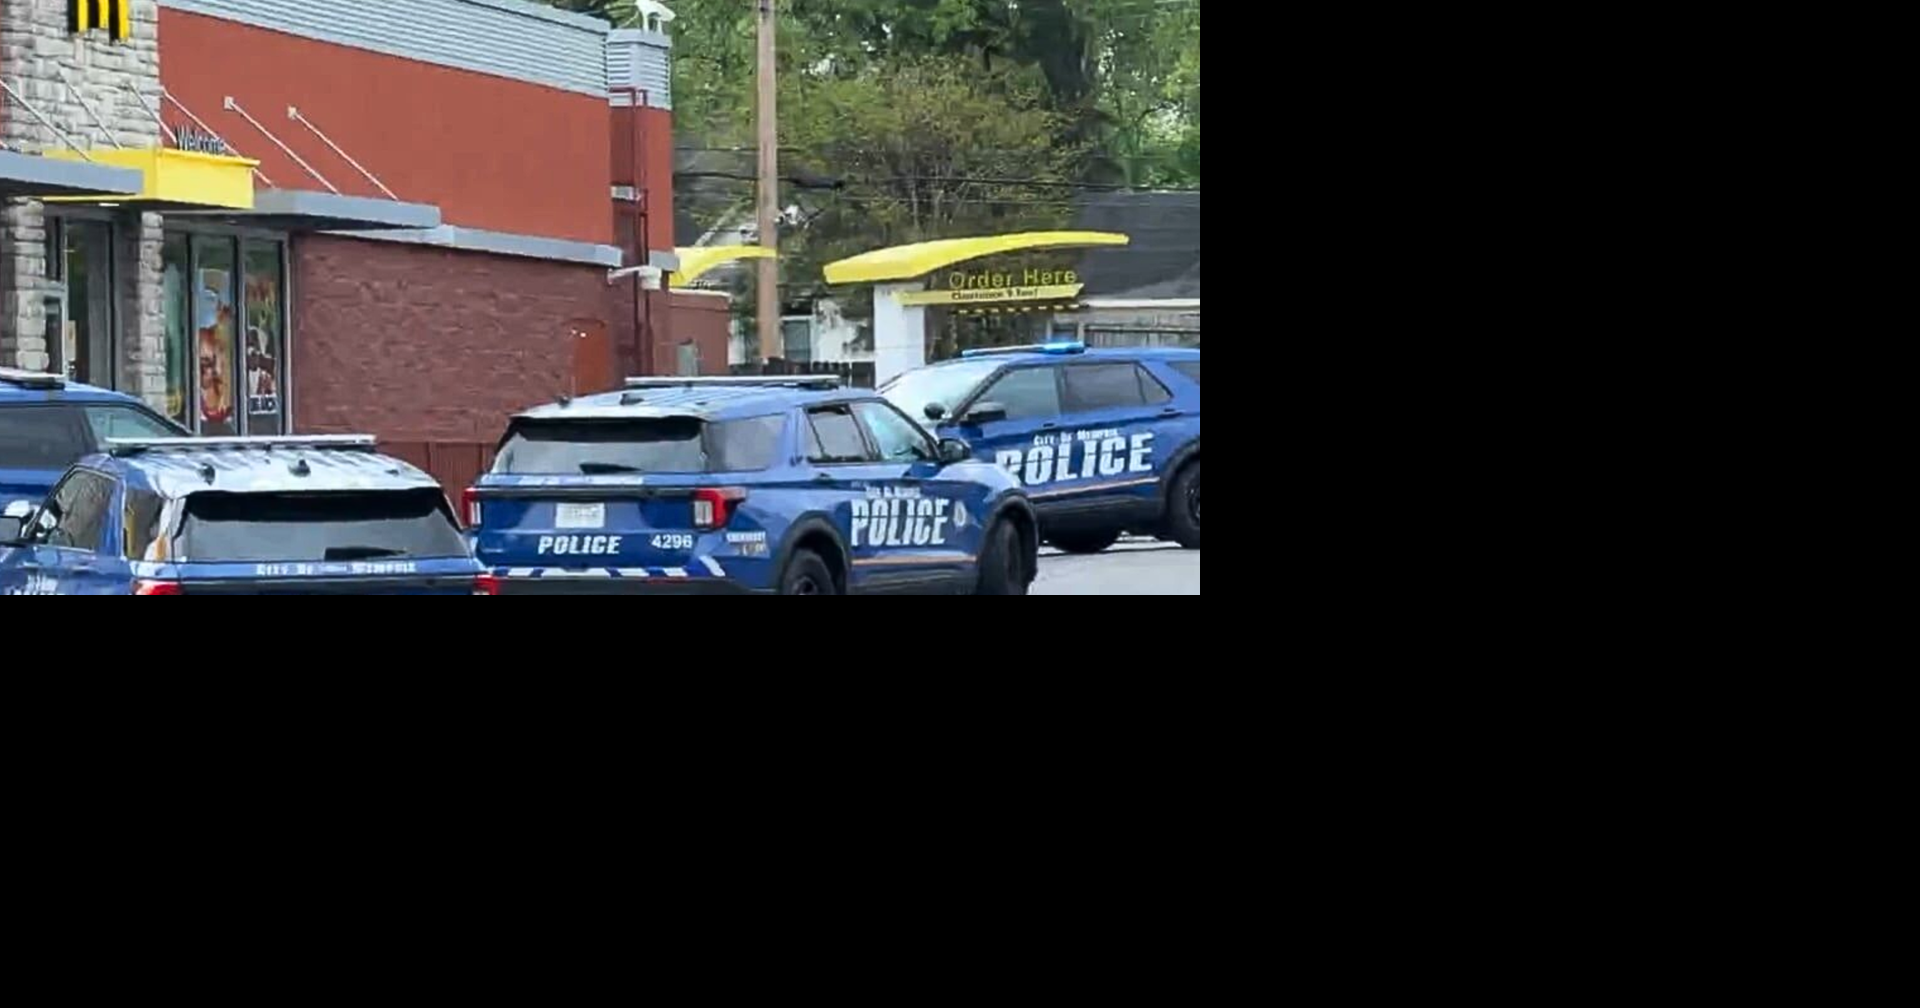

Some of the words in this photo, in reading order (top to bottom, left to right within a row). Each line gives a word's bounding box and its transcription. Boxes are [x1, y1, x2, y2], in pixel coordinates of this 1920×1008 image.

[175, 126, 226, 154] Welcome
[949, 268, 1012, 290] Order
[1023, 267, 1078, 285] Here
[996, 433, 1154, 485] POLICE
[850, 498, 949, 547] POLICE
[538, 535, 622, 555] POLICE
[651, 534, 693, 549] 4296
